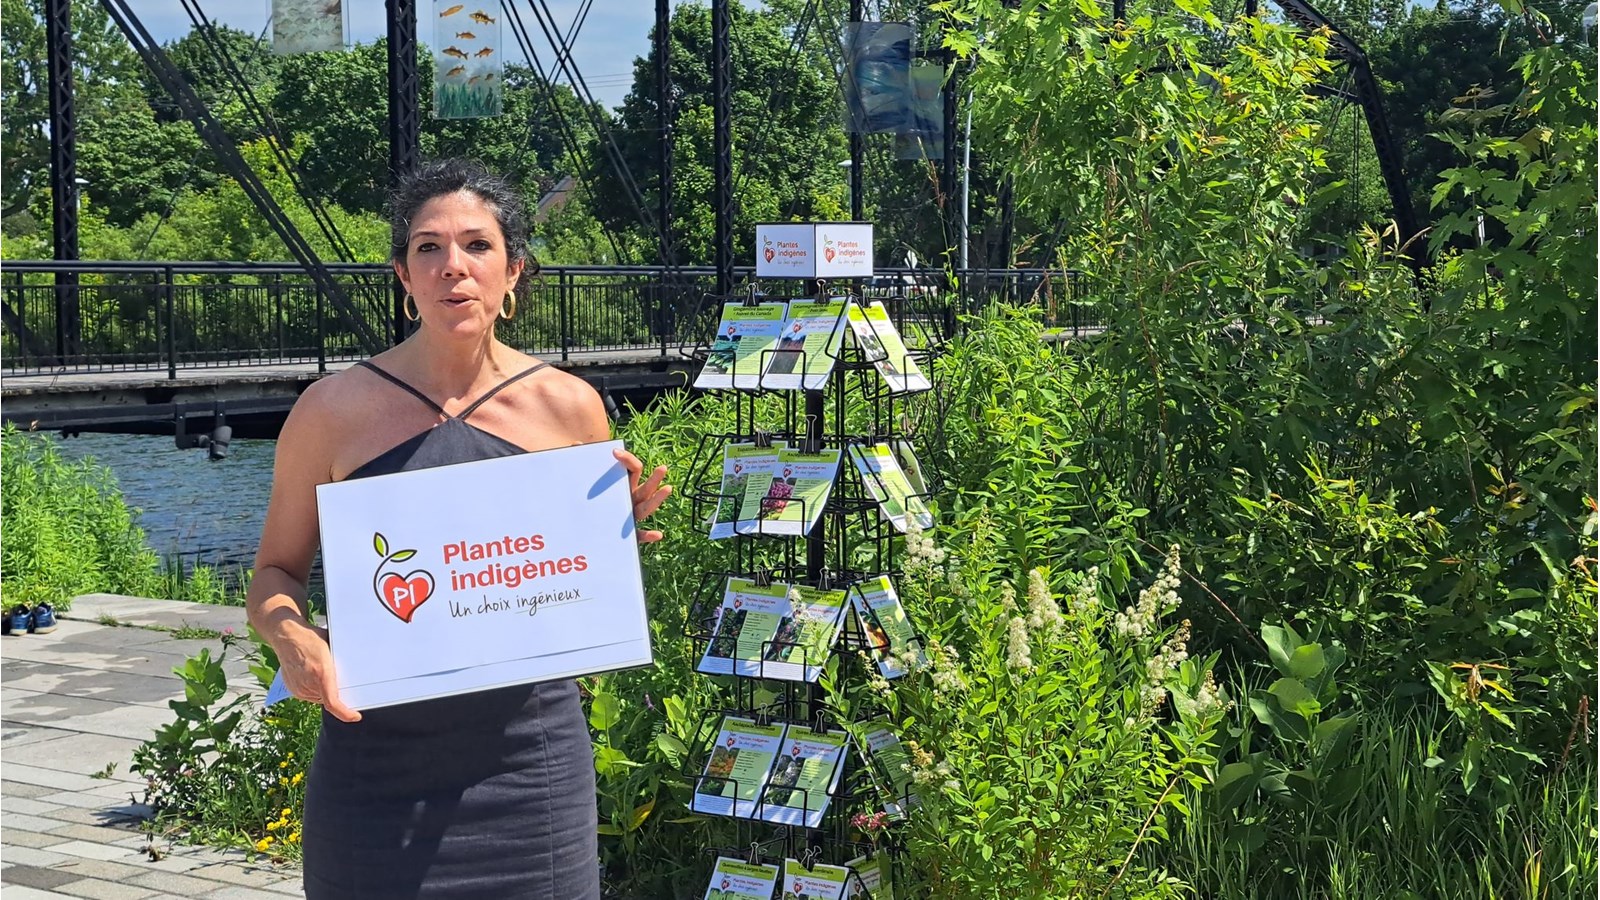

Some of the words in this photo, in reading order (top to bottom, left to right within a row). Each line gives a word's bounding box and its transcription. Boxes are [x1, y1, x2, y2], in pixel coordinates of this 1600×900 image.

[777, 241, 798, 249] Plantes
[778, 249, 807, 258] indigènes
[838, 249, 866, 258] indigènes
[442, 534, 546, 565] Plantes
[450, 553, 588, 592] indigènes
[392, 583, 416, 609] PI
[448, 600, 473, 618] Un
[477, 595, 511, 614] choix
[516, 588, 581, 617] ingénieux
